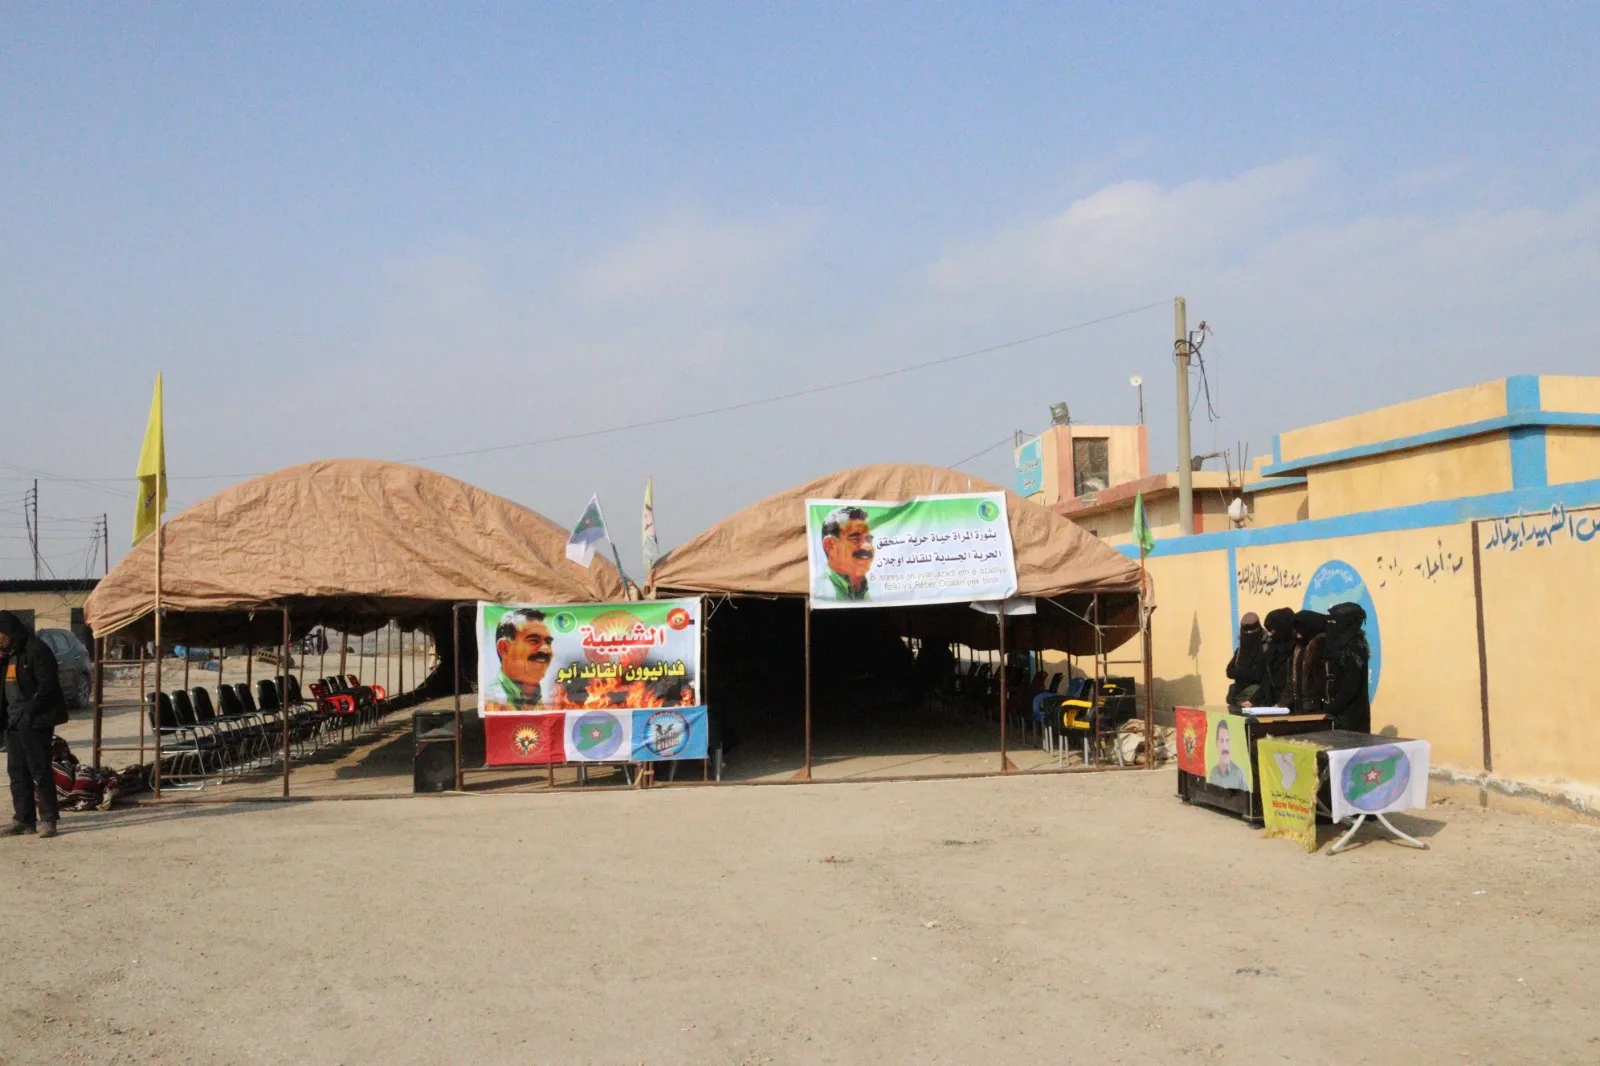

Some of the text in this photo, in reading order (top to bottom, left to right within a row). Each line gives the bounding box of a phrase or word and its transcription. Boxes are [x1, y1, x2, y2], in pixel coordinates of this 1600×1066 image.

[930, 533, 951, 545] حياة
[933, 552, 972, 565] الجسدية
[972, 549, 1002, 563] الحرية
[580, 624, 665, 653] الشبيبة
[556, 663, 578, 684] آبو
[580, 662, 623, 678] القائد
